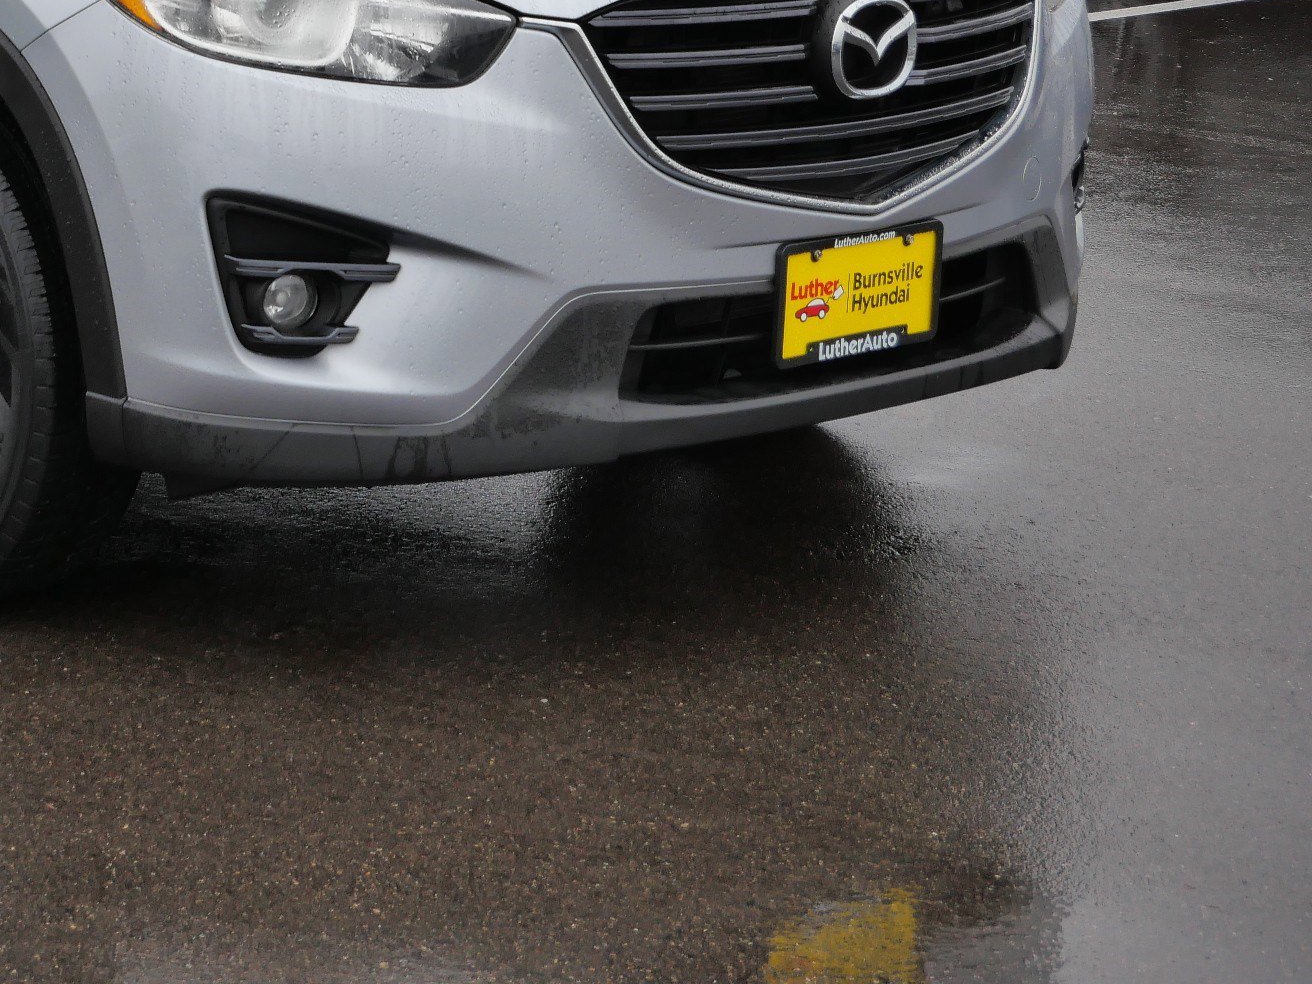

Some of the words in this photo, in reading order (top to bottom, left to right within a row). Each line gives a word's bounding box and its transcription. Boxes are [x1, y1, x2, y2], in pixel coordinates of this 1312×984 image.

[834, 230, 896, 248] LutherAuto.com
[790, 278, 840, 301] Luther
[853, 261, 924, 291] Burnsville
[851, 283, 911, 314] Hyundai
[818, 330, 898, 362] LutherAuto
